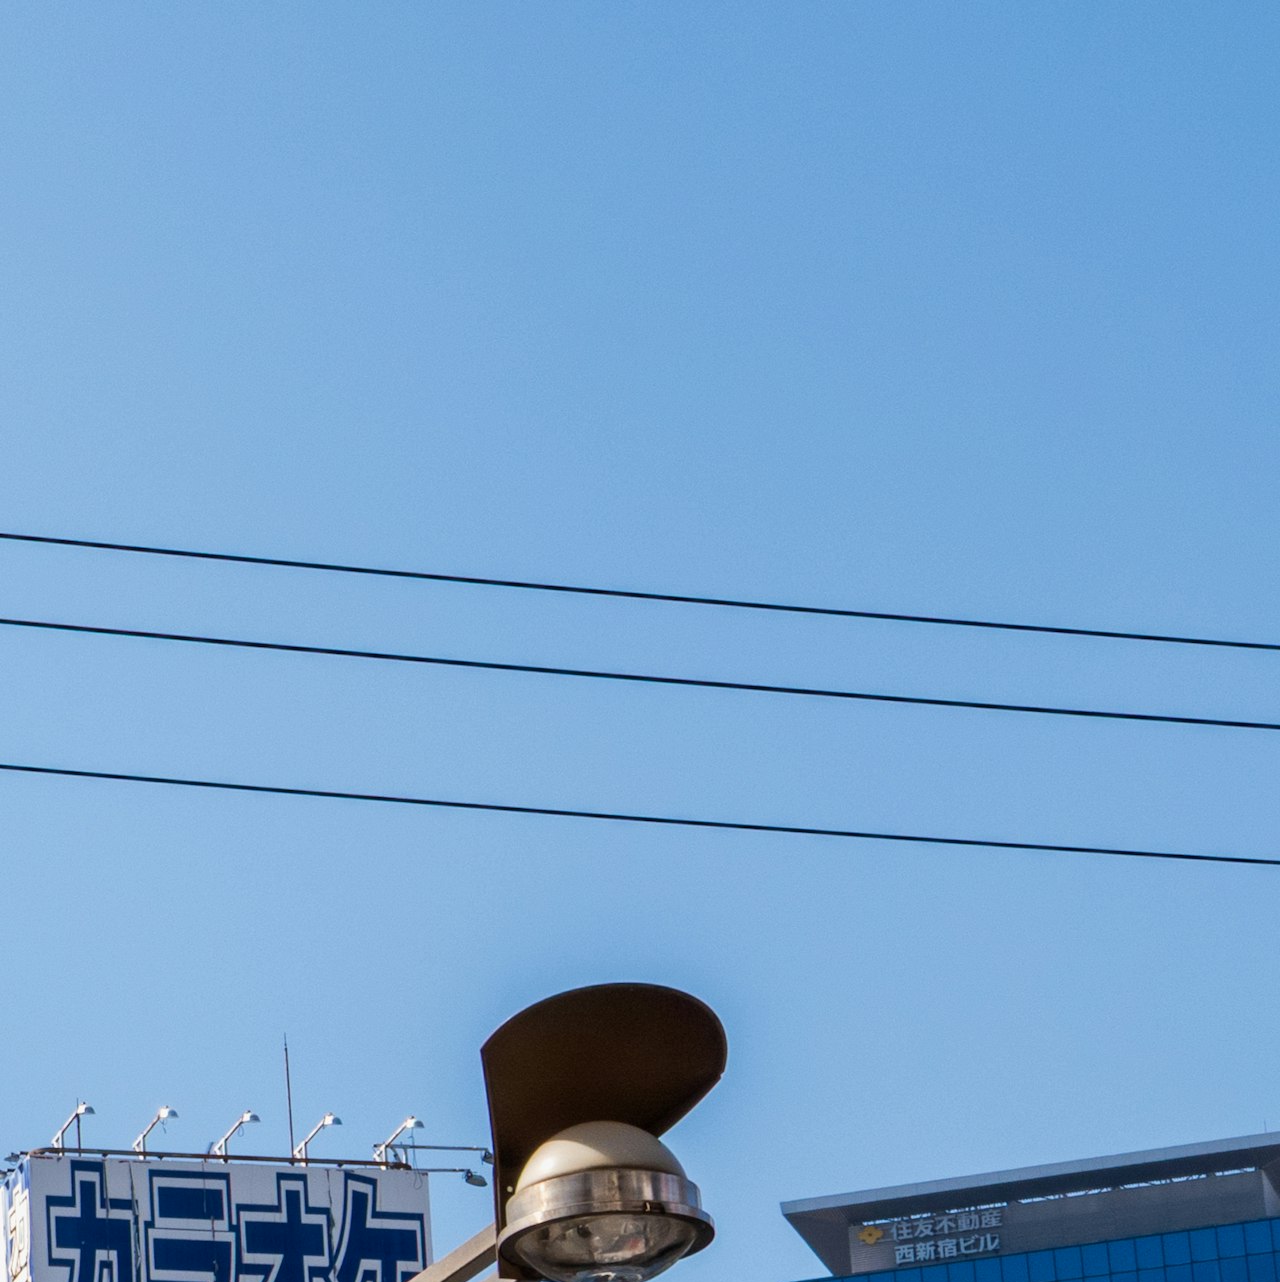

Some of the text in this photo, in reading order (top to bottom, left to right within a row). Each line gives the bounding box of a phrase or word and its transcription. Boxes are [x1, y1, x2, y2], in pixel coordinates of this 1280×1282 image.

[891, 1209, 1003, 1242] 住友不動産
[894, 1233, 1001, 1265] 西新宿ビル
